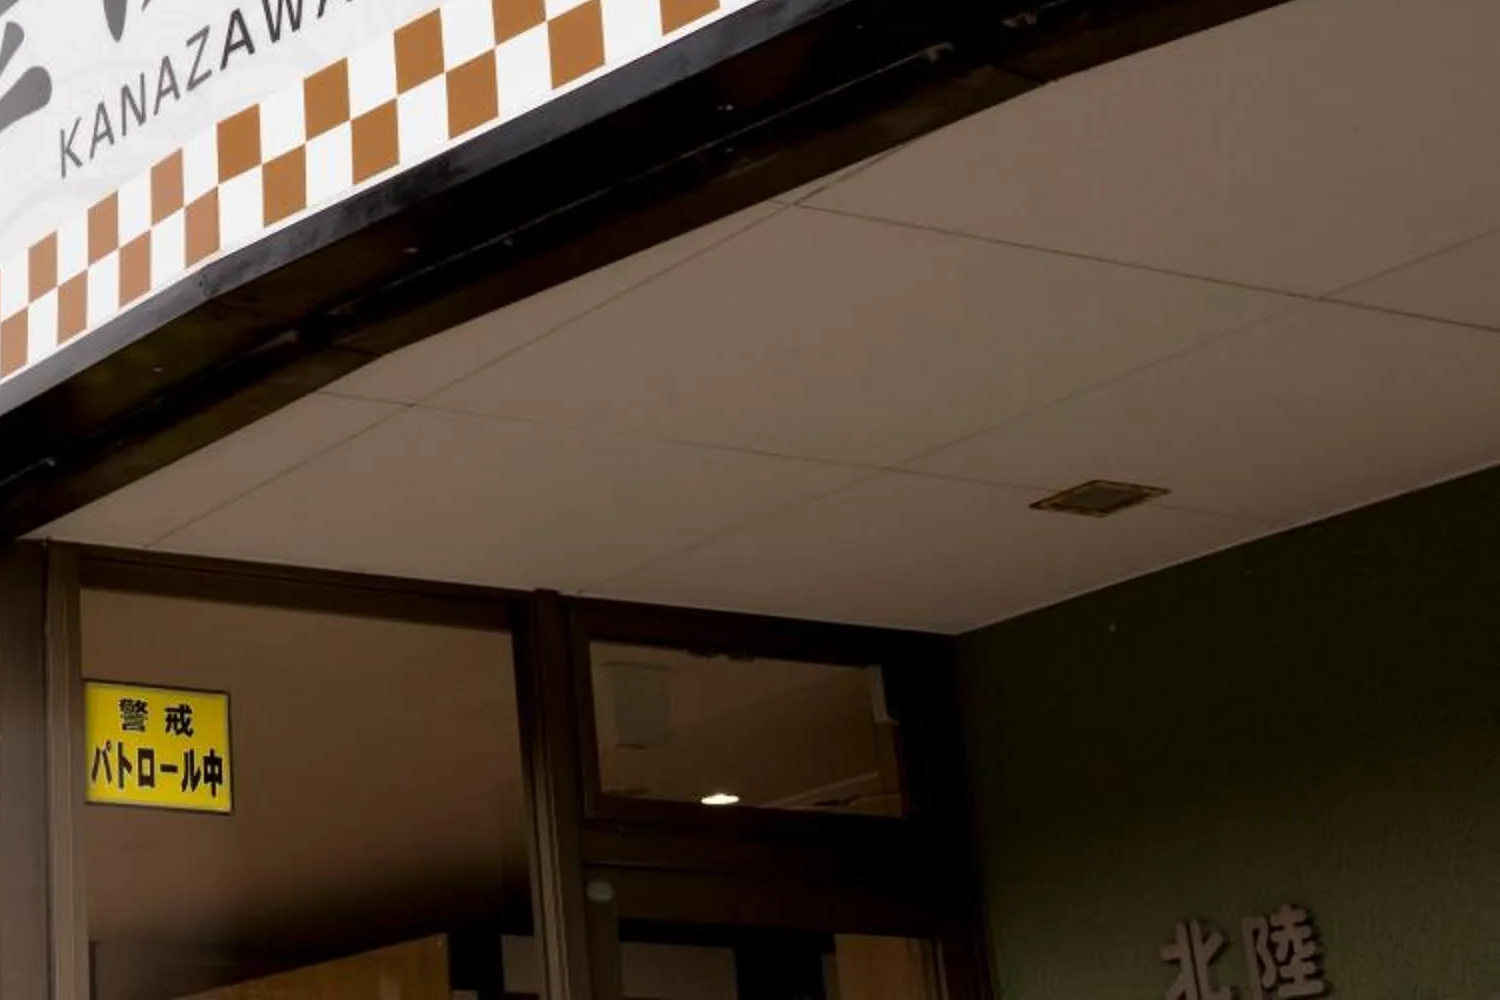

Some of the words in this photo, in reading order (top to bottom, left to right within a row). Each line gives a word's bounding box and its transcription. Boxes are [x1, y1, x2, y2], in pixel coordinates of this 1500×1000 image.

[119, 698, 194, 738] 警戒
[91, 740, 224, 797] パトロール中
[1160, 903, 1326, 1000] 北陸
